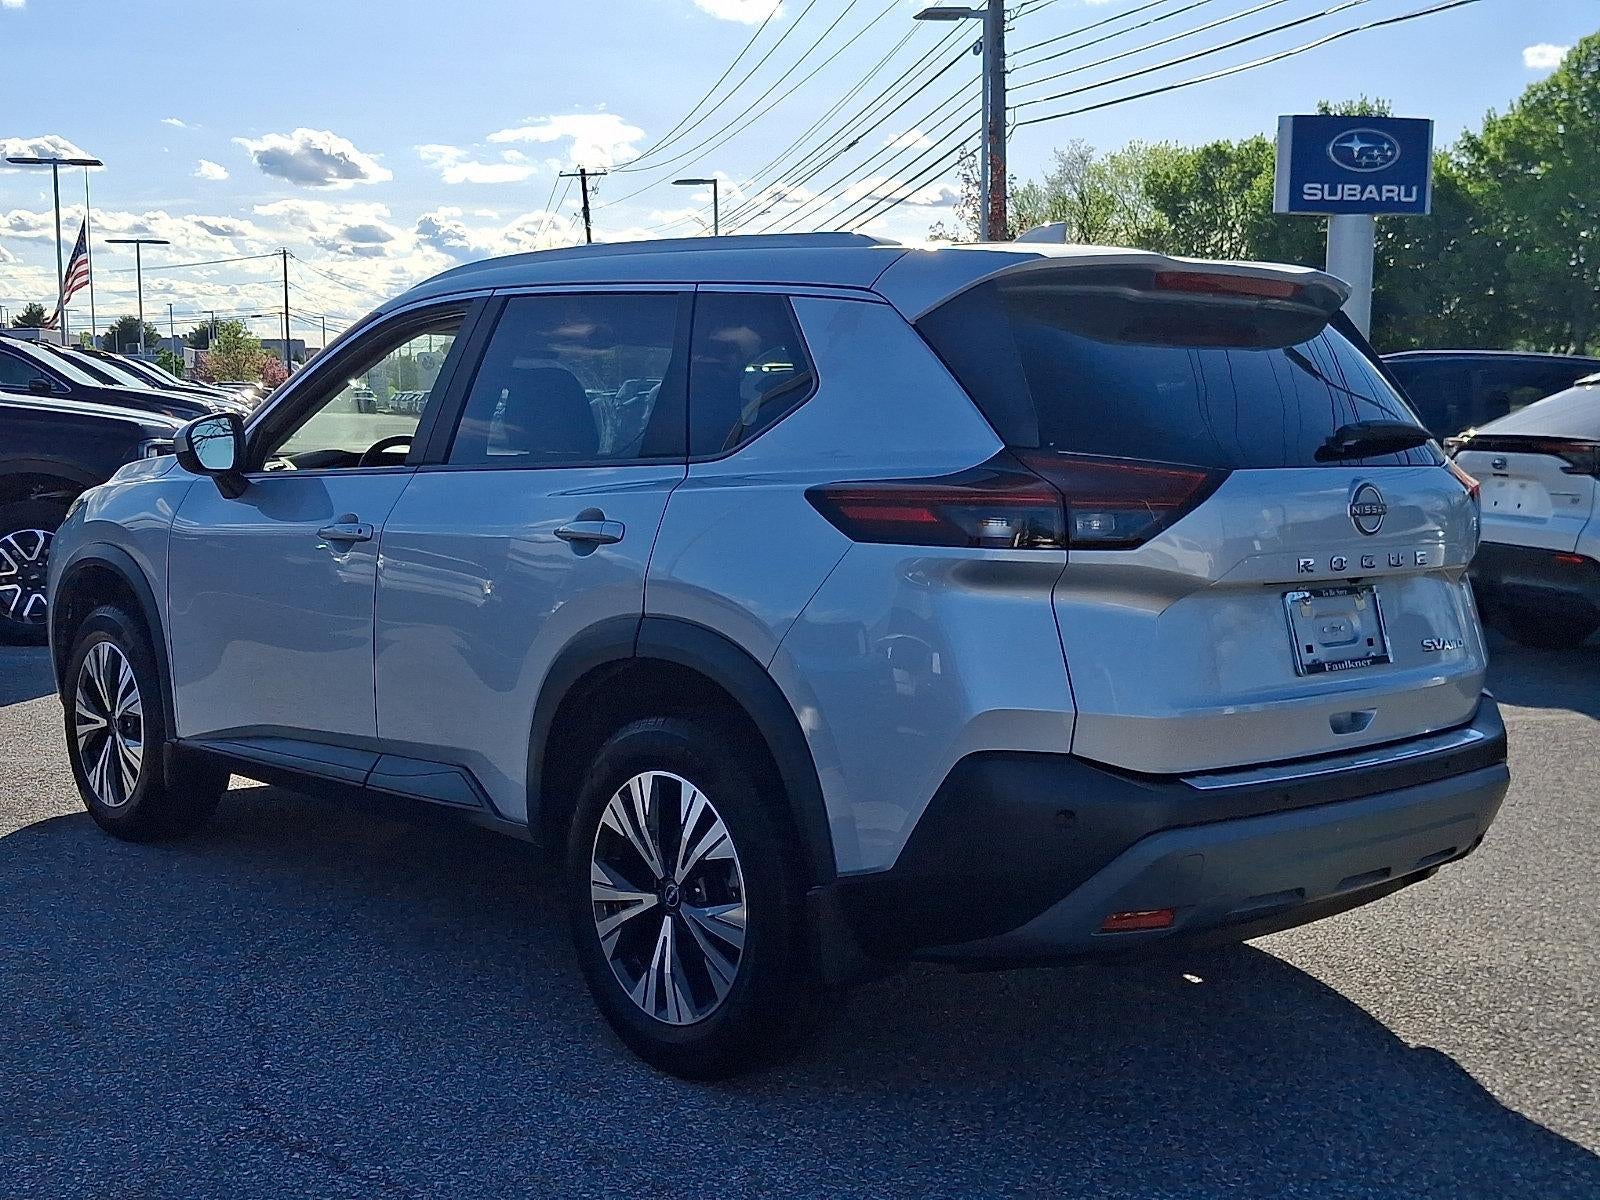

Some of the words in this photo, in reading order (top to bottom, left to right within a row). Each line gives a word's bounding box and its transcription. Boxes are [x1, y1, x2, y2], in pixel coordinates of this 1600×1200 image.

[1303, 183, 1418, 202] SUBARU
[1298, 552, 1427, 573] ROGUE
[1324, 659, 1373, 671] Faulkner
